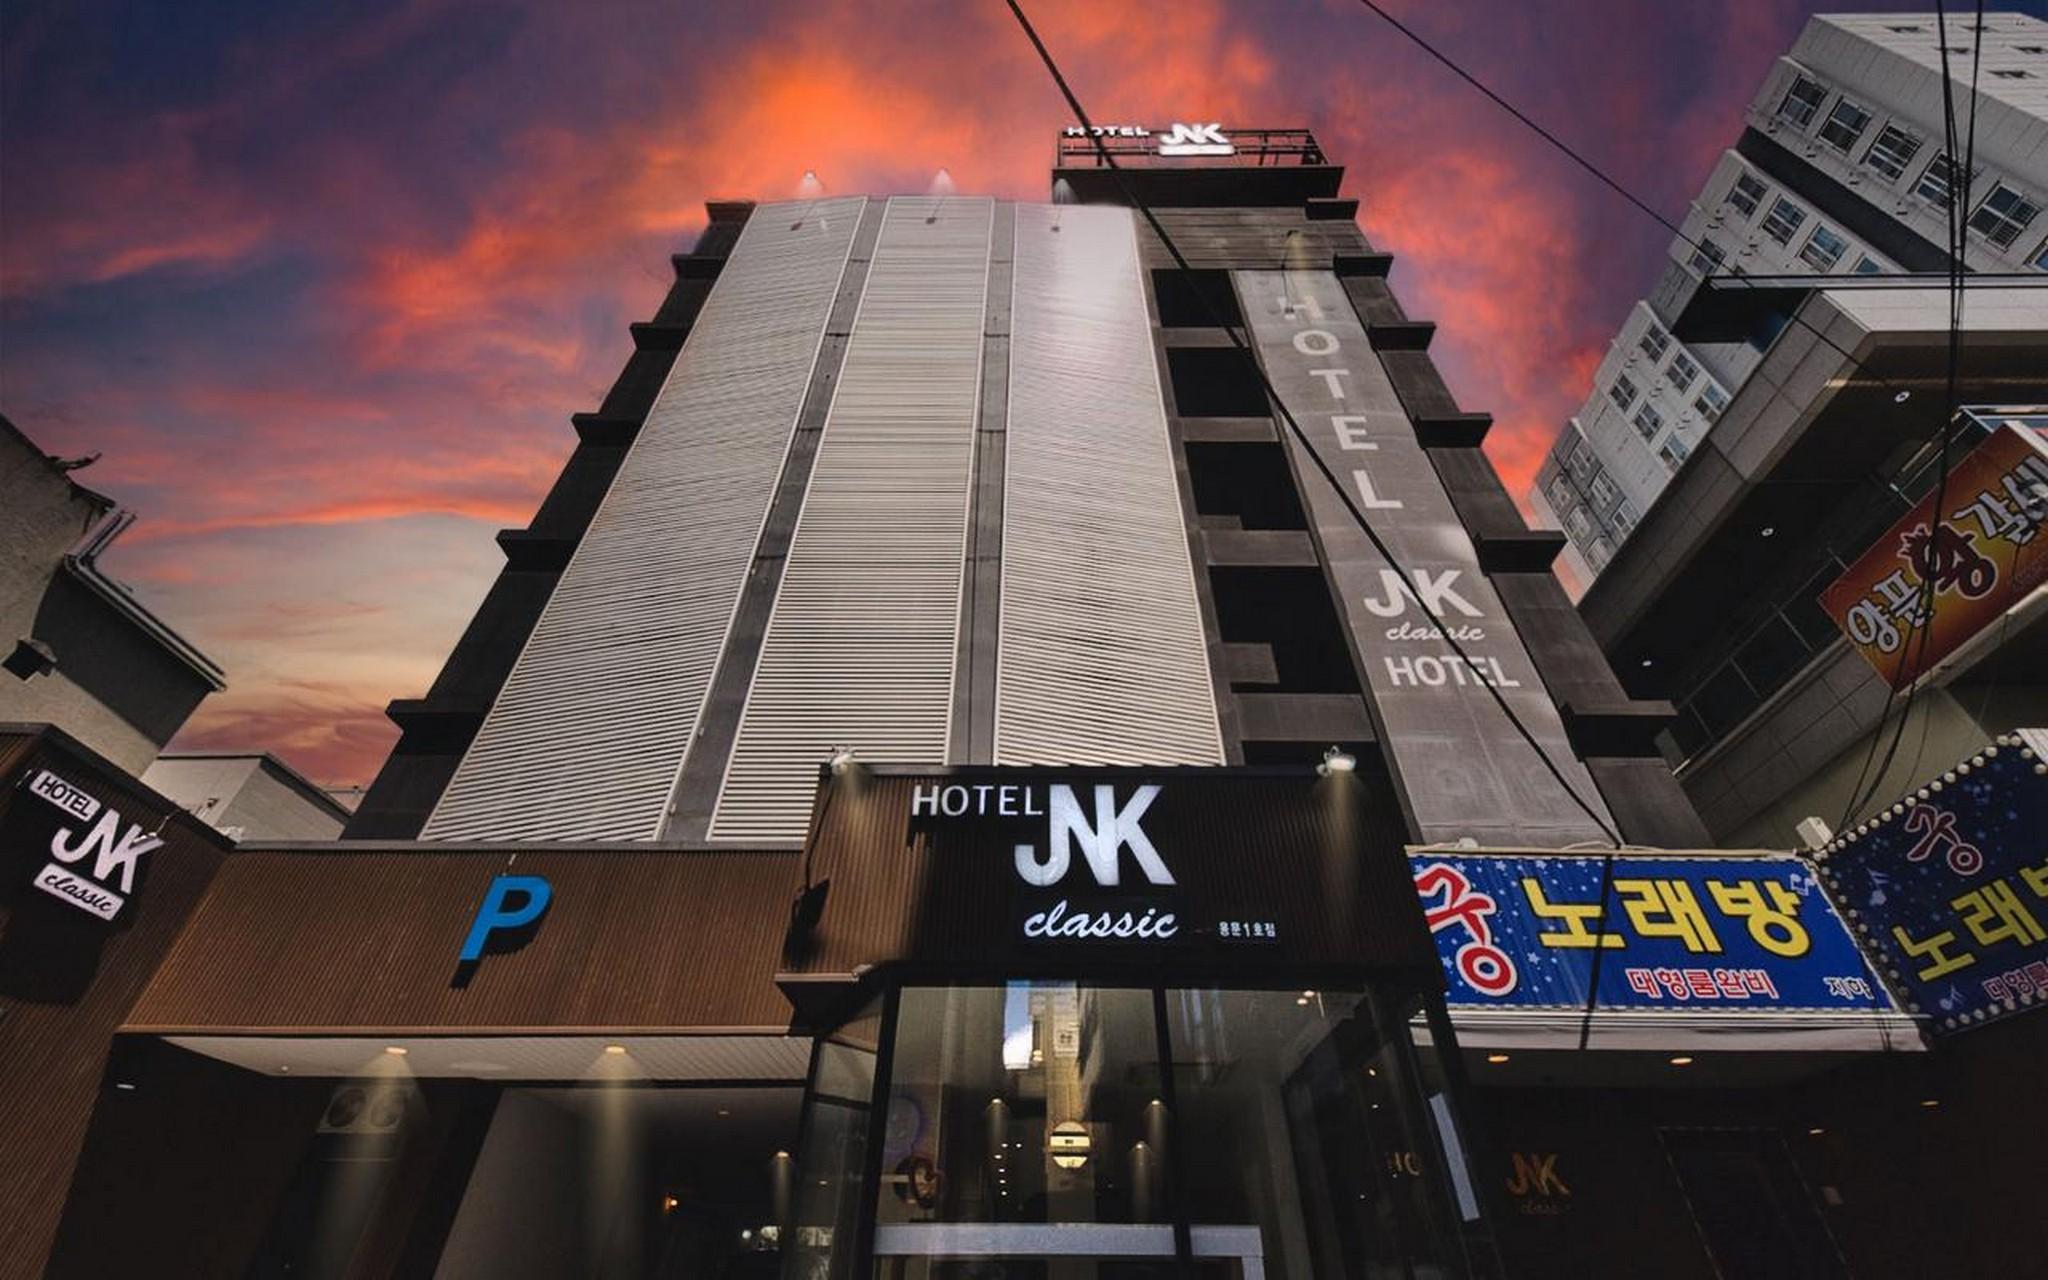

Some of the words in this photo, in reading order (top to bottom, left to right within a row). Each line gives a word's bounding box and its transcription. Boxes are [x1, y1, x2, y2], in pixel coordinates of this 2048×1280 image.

[1160, 123, 1229, 145] JNK
[1277, 295, 1404, 509] HOTEL
[1384, 656, 1520, 687] HOTEL
[37, 776, 91, 818] HOTEL
[51, 808, 165, 894] JNK
[911, 784, 1044, 816] HOTEL
[1014, 784, 1178, 887] JNK
[44, 874, 113, 912] classic
[459, 876, 552, 960] P
[1023, 900, 1179, 939] classic
[1522, 878, 1812, 957] 노래방
[1625, 967, 1780, 999] 대형룸완비
